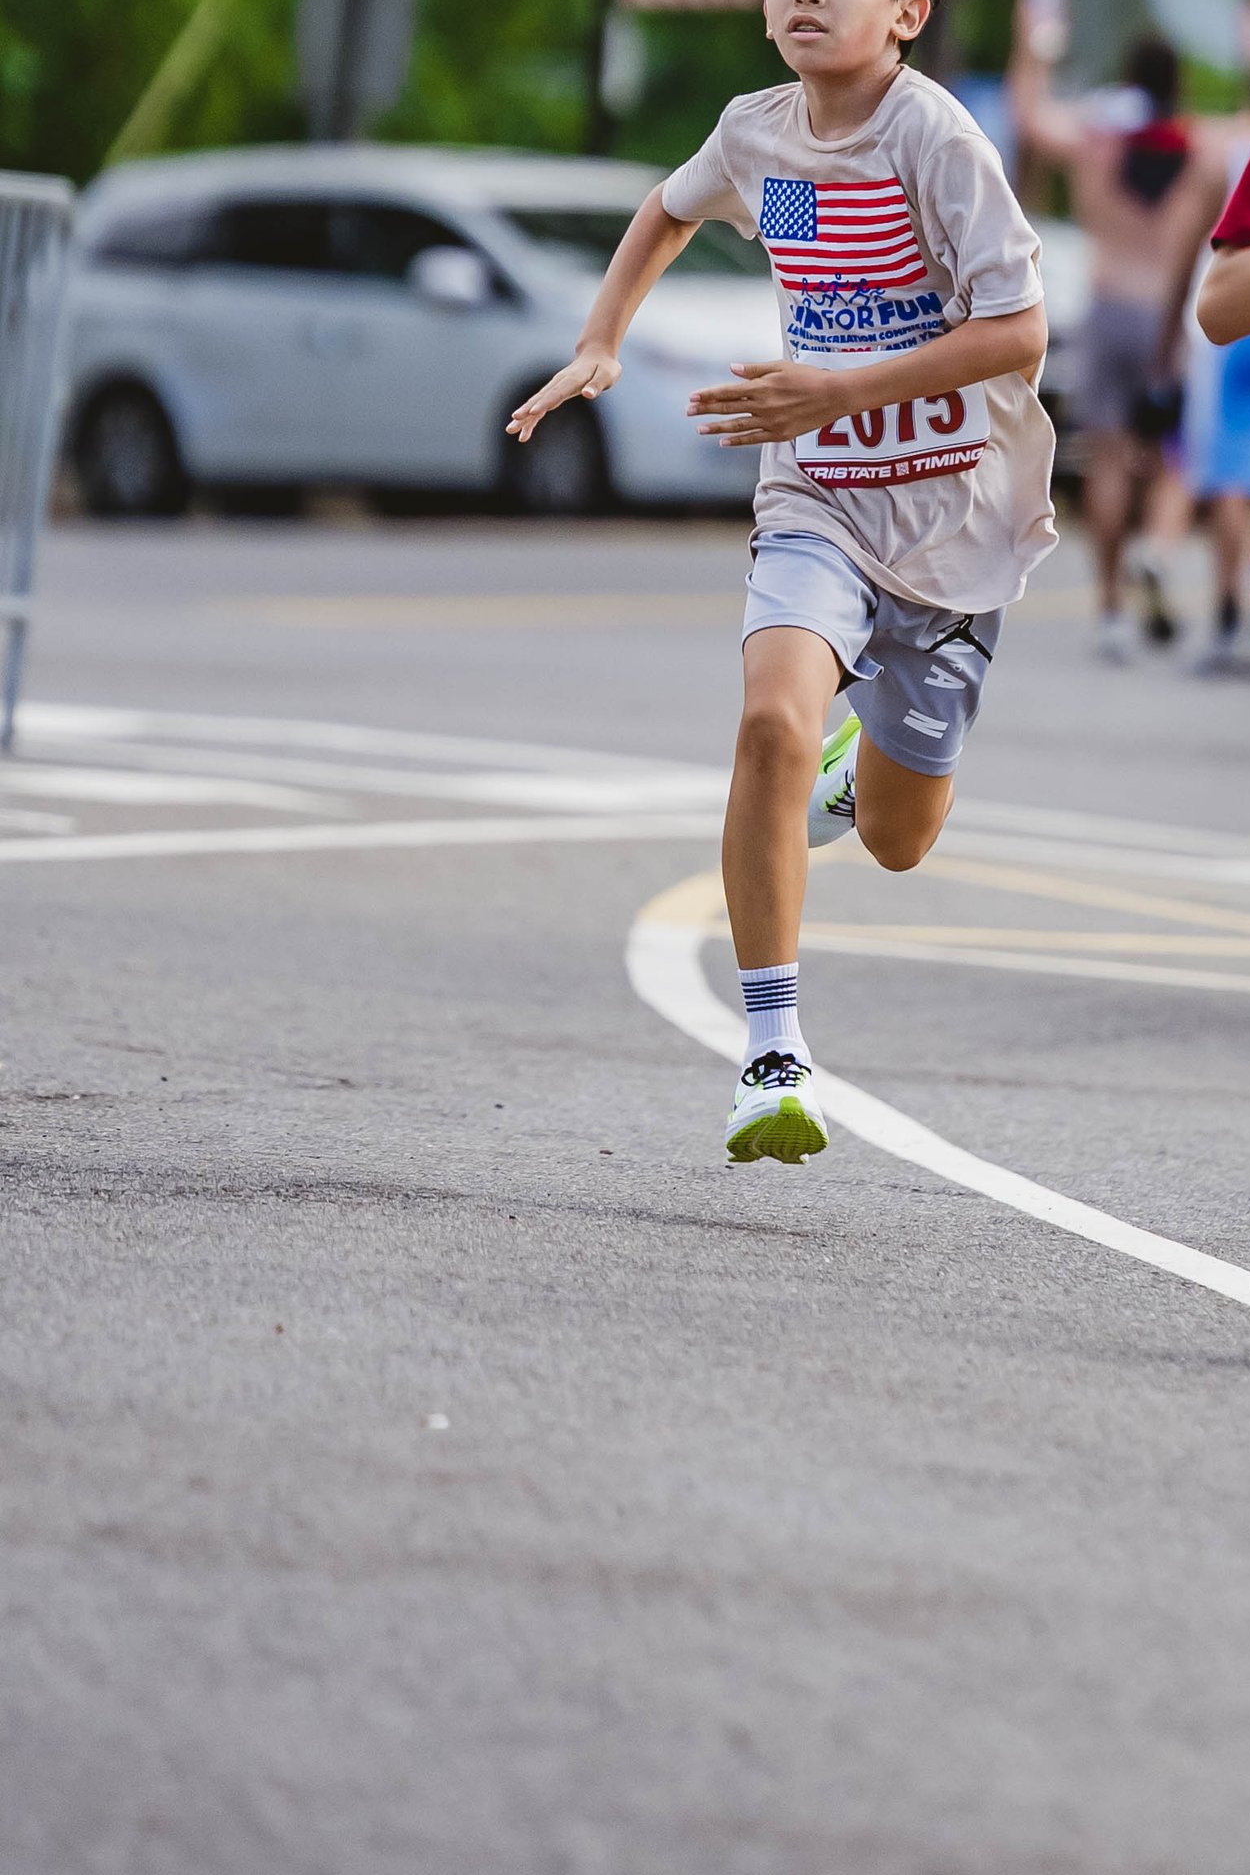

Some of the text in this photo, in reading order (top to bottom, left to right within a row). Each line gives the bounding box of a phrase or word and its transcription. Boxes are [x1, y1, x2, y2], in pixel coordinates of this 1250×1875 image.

[821, 306, 875, 331] FOR
[877, 292, 943, 326] FUN
[803, 447, 986, 480] TRISTATE TIMING
